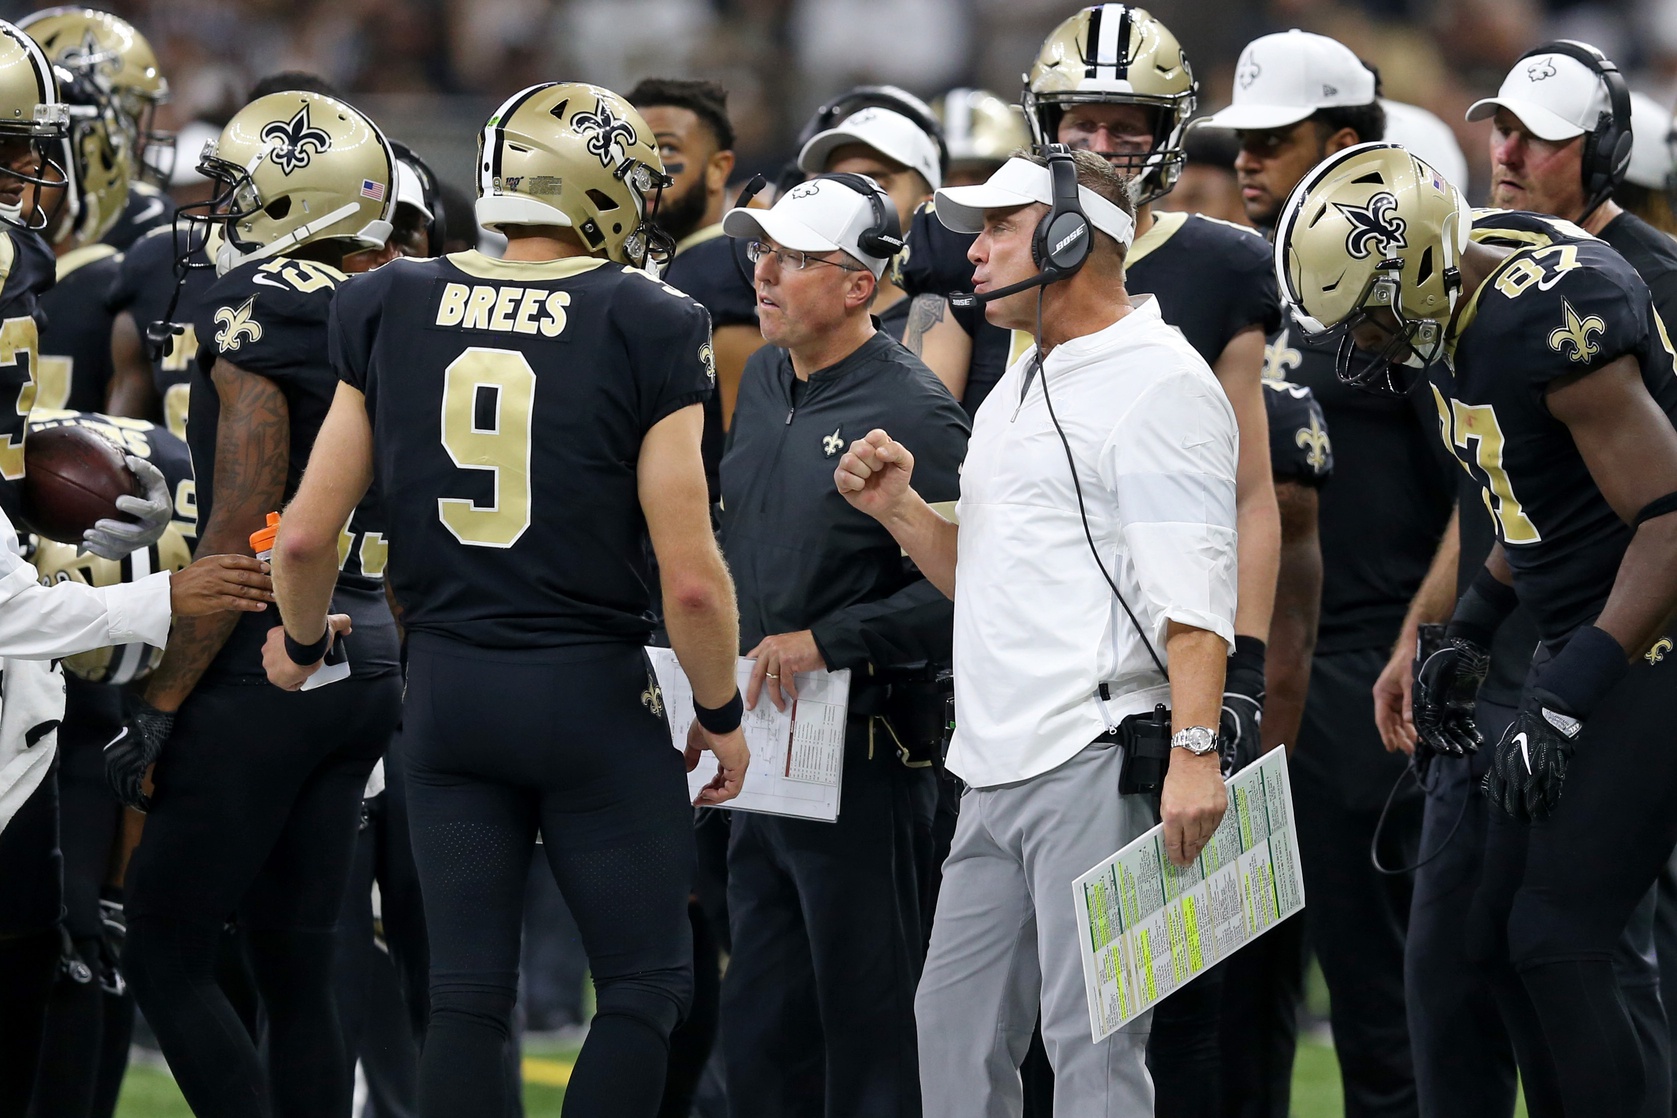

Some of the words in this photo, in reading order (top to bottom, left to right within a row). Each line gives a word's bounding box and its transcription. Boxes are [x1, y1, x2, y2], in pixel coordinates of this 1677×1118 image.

[877, 234, 904, 247] BOSE
[1051, 223, 1086, 256] BOSE
[1494, 245, 1582, 299] 87
[436, 282, 571, 338] BREES
[437, 346, 537, 549] 9
